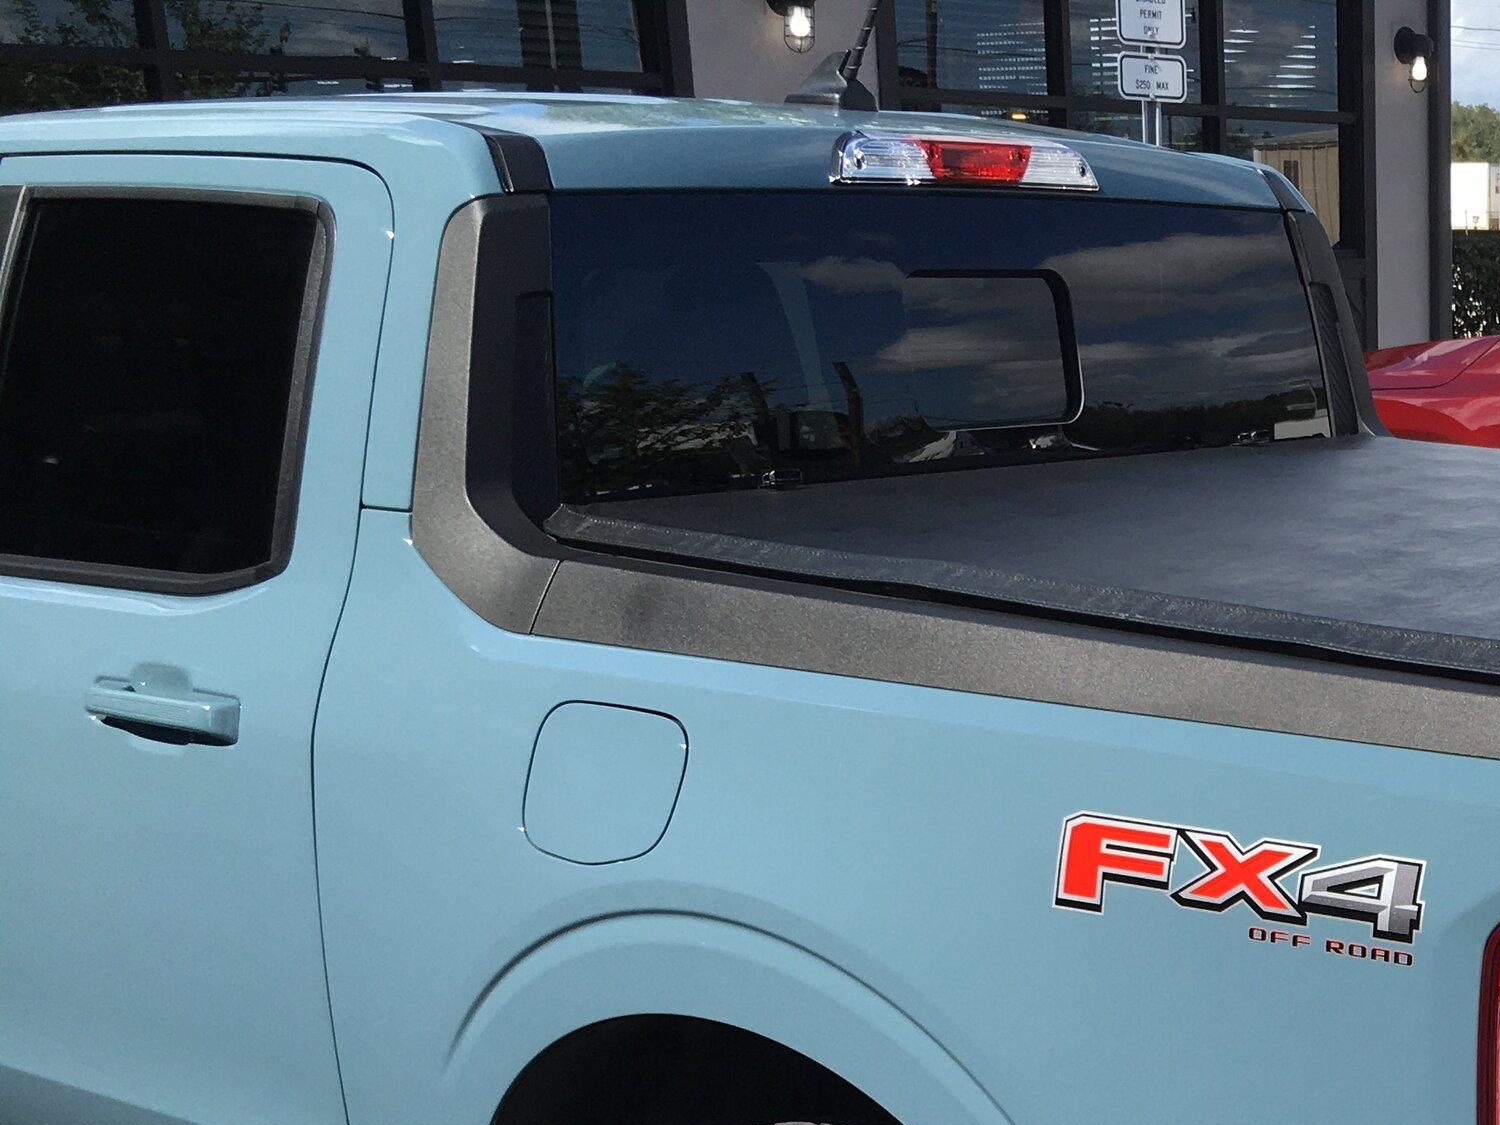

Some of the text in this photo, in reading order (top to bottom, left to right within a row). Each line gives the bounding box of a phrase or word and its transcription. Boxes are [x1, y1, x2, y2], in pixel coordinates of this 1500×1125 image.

[1139, 9, 1162, 20] PERMIT
[1143, 25, 1160, 36] ONLY
[1144, 64, 1159, 75] FINE
[1135, 78, 1169, 91] $250 MAX
[1052, 810, 1427, 945] FX4
[1248, 926, 1414, 967] OFF ROAD
